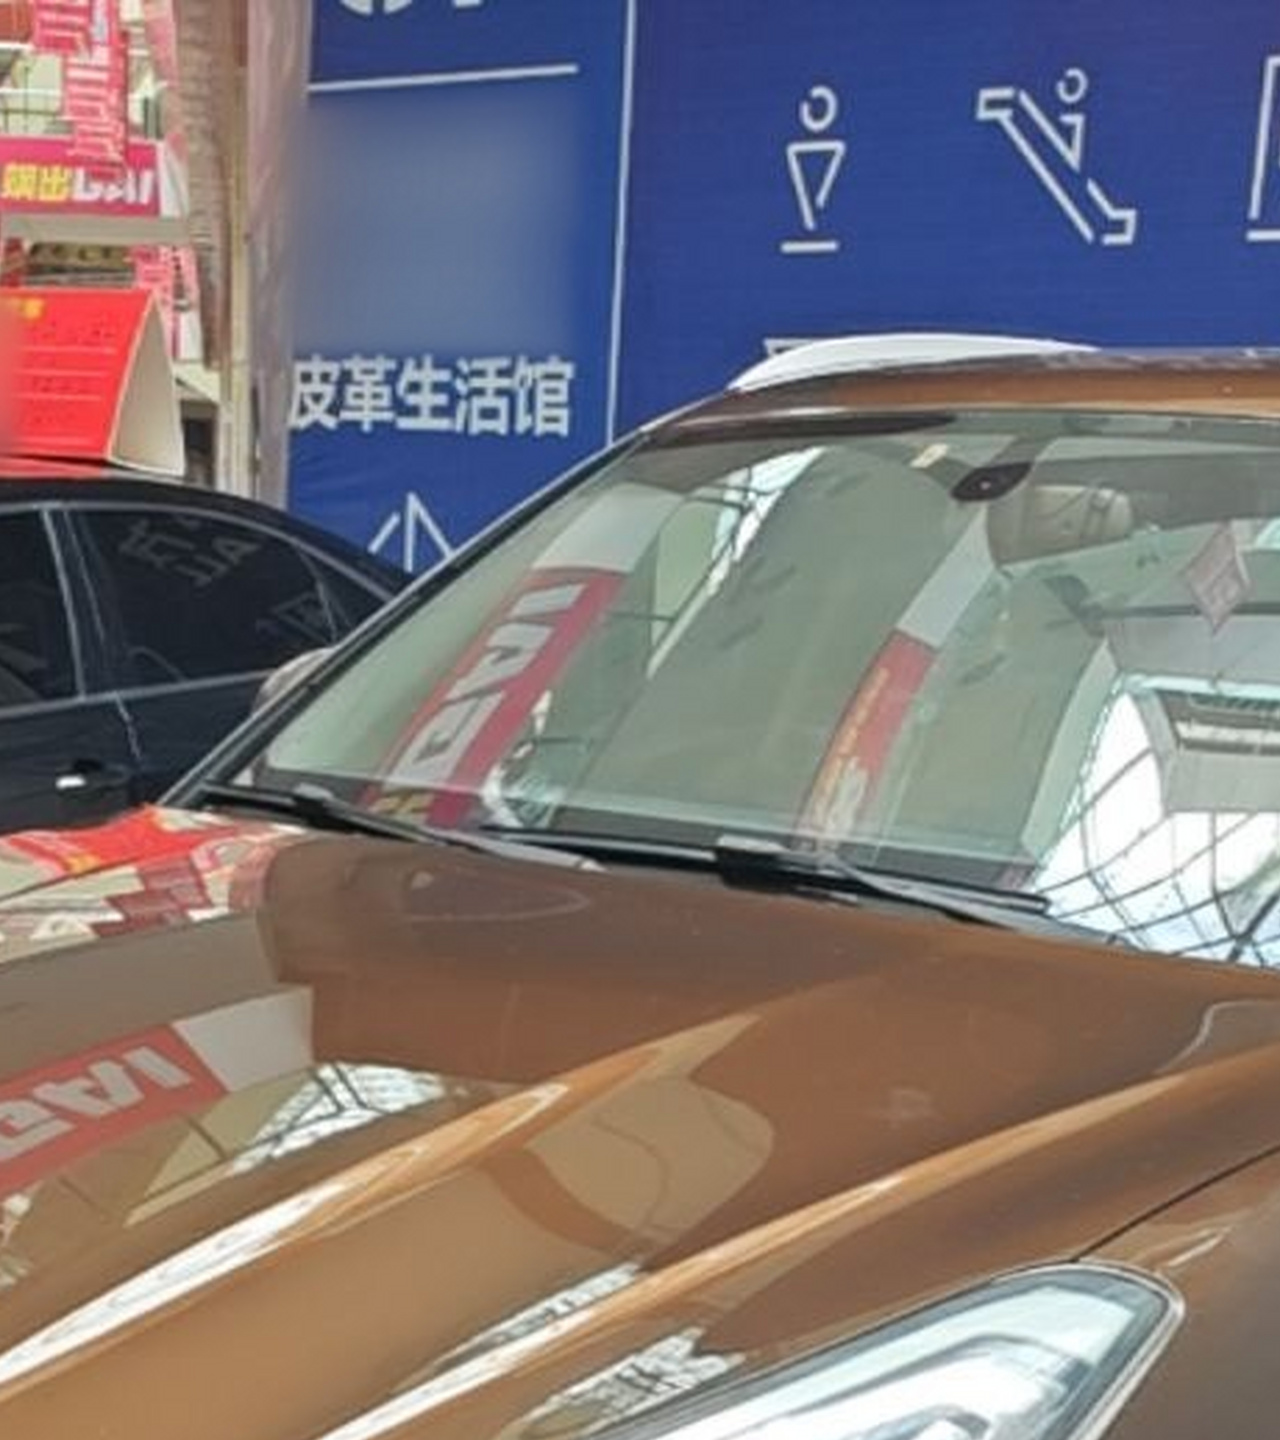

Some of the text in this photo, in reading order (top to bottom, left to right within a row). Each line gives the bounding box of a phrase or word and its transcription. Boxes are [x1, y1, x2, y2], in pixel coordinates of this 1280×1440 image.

[288, 354, 575, 437] 皮革生活馆
